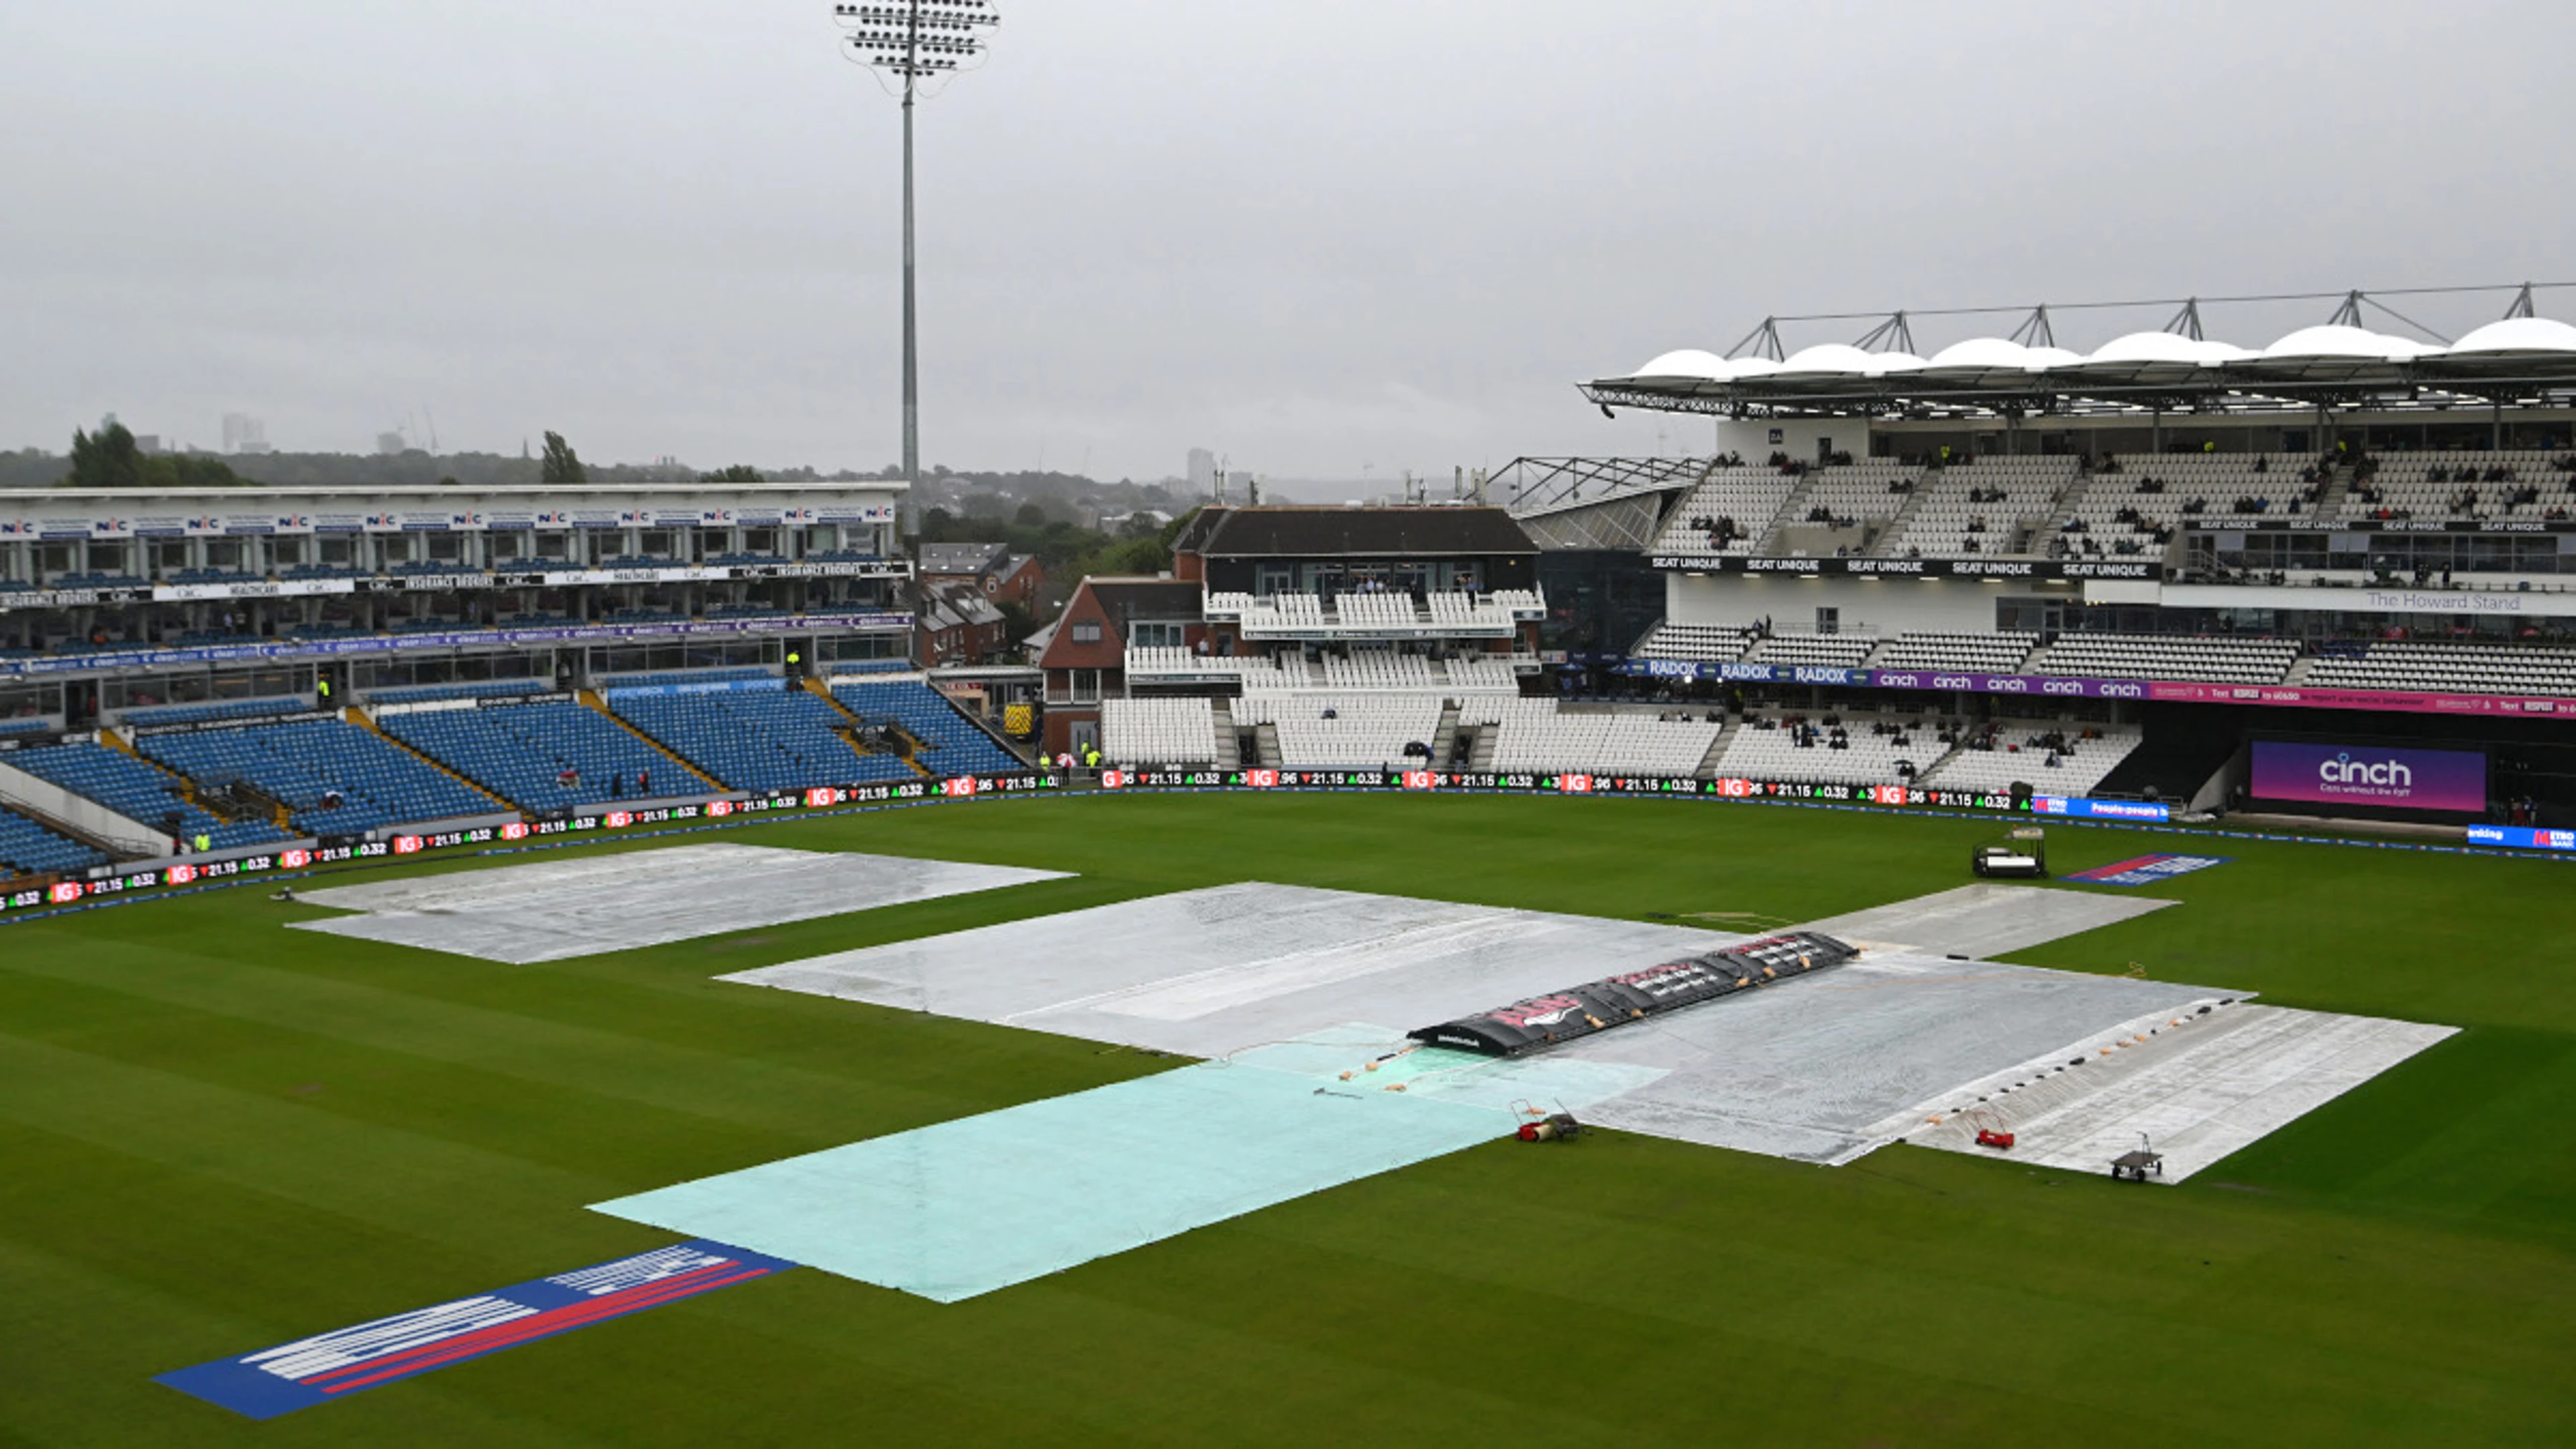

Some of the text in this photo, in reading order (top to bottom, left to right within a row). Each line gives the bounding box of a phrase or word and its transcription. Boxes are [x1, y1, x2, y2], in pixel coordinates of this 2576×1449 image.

[2383, 522, 2445, 530] SEAT UNIQUE
[1653, 559, 1721, 569] SEAT UNIQUE
[1748, 560, 1819, 571] SEAT UNIQUE
[1848, 561, 1923, 572] SEAT UNIQUE
[1953, 562, 2031, 574] SEAT UNIQUE
[2063, 565, 2147, 577] SEAT UNIQUE
[2368, 593, 2520, 610] The Howard Stand
[1650, 661, 1698, 676] RADOX
[1721, 664, 1771, 679] RADOX
[1796, 668, 1846, 683] RADOX
[1880, 674, 1917, 687] cinch
[1933, 674, 1971, 689] cinch
[1987, 676, 2027, 691] cinch
[2043, 678, 2083, 694] cinch
[2100, 680, 2141, 696] cinch
[2320, 752, 2412, 786] cinch
[1104, 772, 1116, 785] G
[1150, 773, 1181, 785] 21.15
[1195, 773, 1220, 785] 0.32
[1255, 771, 1272, 785] IG
[1311, 773, 1344, 785] 21.15
[1357, 773, 1383, 785] 0.32
[1410, 773, 1428, 786] IG
[1462, 775, 1495, 786] 21.15
[1509, 775, 1533, 786] 0.32
[1568, 776, 1585, 790] IG
[1625, 779, 1658, 791] 21.15
[1672, 780, 1697, 792] 0.32
[1725, 781, 1743, 795] IG
[1778, 786, 1811, 797] 21.15
[1824, 786, 1849, 798] 0.32
[1882, 789, 1899, 802] IG
[1939, 794, 1971, 806] 21.15
[1986, 797, 2010, 809] 0.32
[15, 890, 40, 906] 0.32
[56, 885, 72, 902] IG
[94, 877, 123, 894] 21.15
[133, 873, 156, 887] 0.32
[172, 866, 189, 882] IG
[208, 862, 237, 877] 21.15
[248, 858, 270, 871] 0.32
[287, 852, 302, 866] IG
[323, 847, 350, 861] 21.15
[360, 843, 386, 856] 0.32
[402, 839, 415, 853] IG
[435, 833, 462, 847] 21.15
[470, 829, 492, 841] 0.32
[506, 824, 520, 839] IG
[541, 821, 566, 833] 21.15
[576, 818, 596, 830] 0.32
[611, 813, 625, 826] IG
[643, 809, 669, 822] 21.15
[678, 806, 697, 817] 0.32
[712, 802, 725, 815] IG
[743, 798, 769, 811] 21.15
[777, 796, 796, 808] 0.32
[814, 791, 829, 805] IG
[858, 787, 889, 800] 21.15
[900, 784, 923, 796] 0.32
[953, 780, 969, 795] IG
[1006, 777, 1036, 790] 21.15
[2534, 830, 2575, 846] METRO
